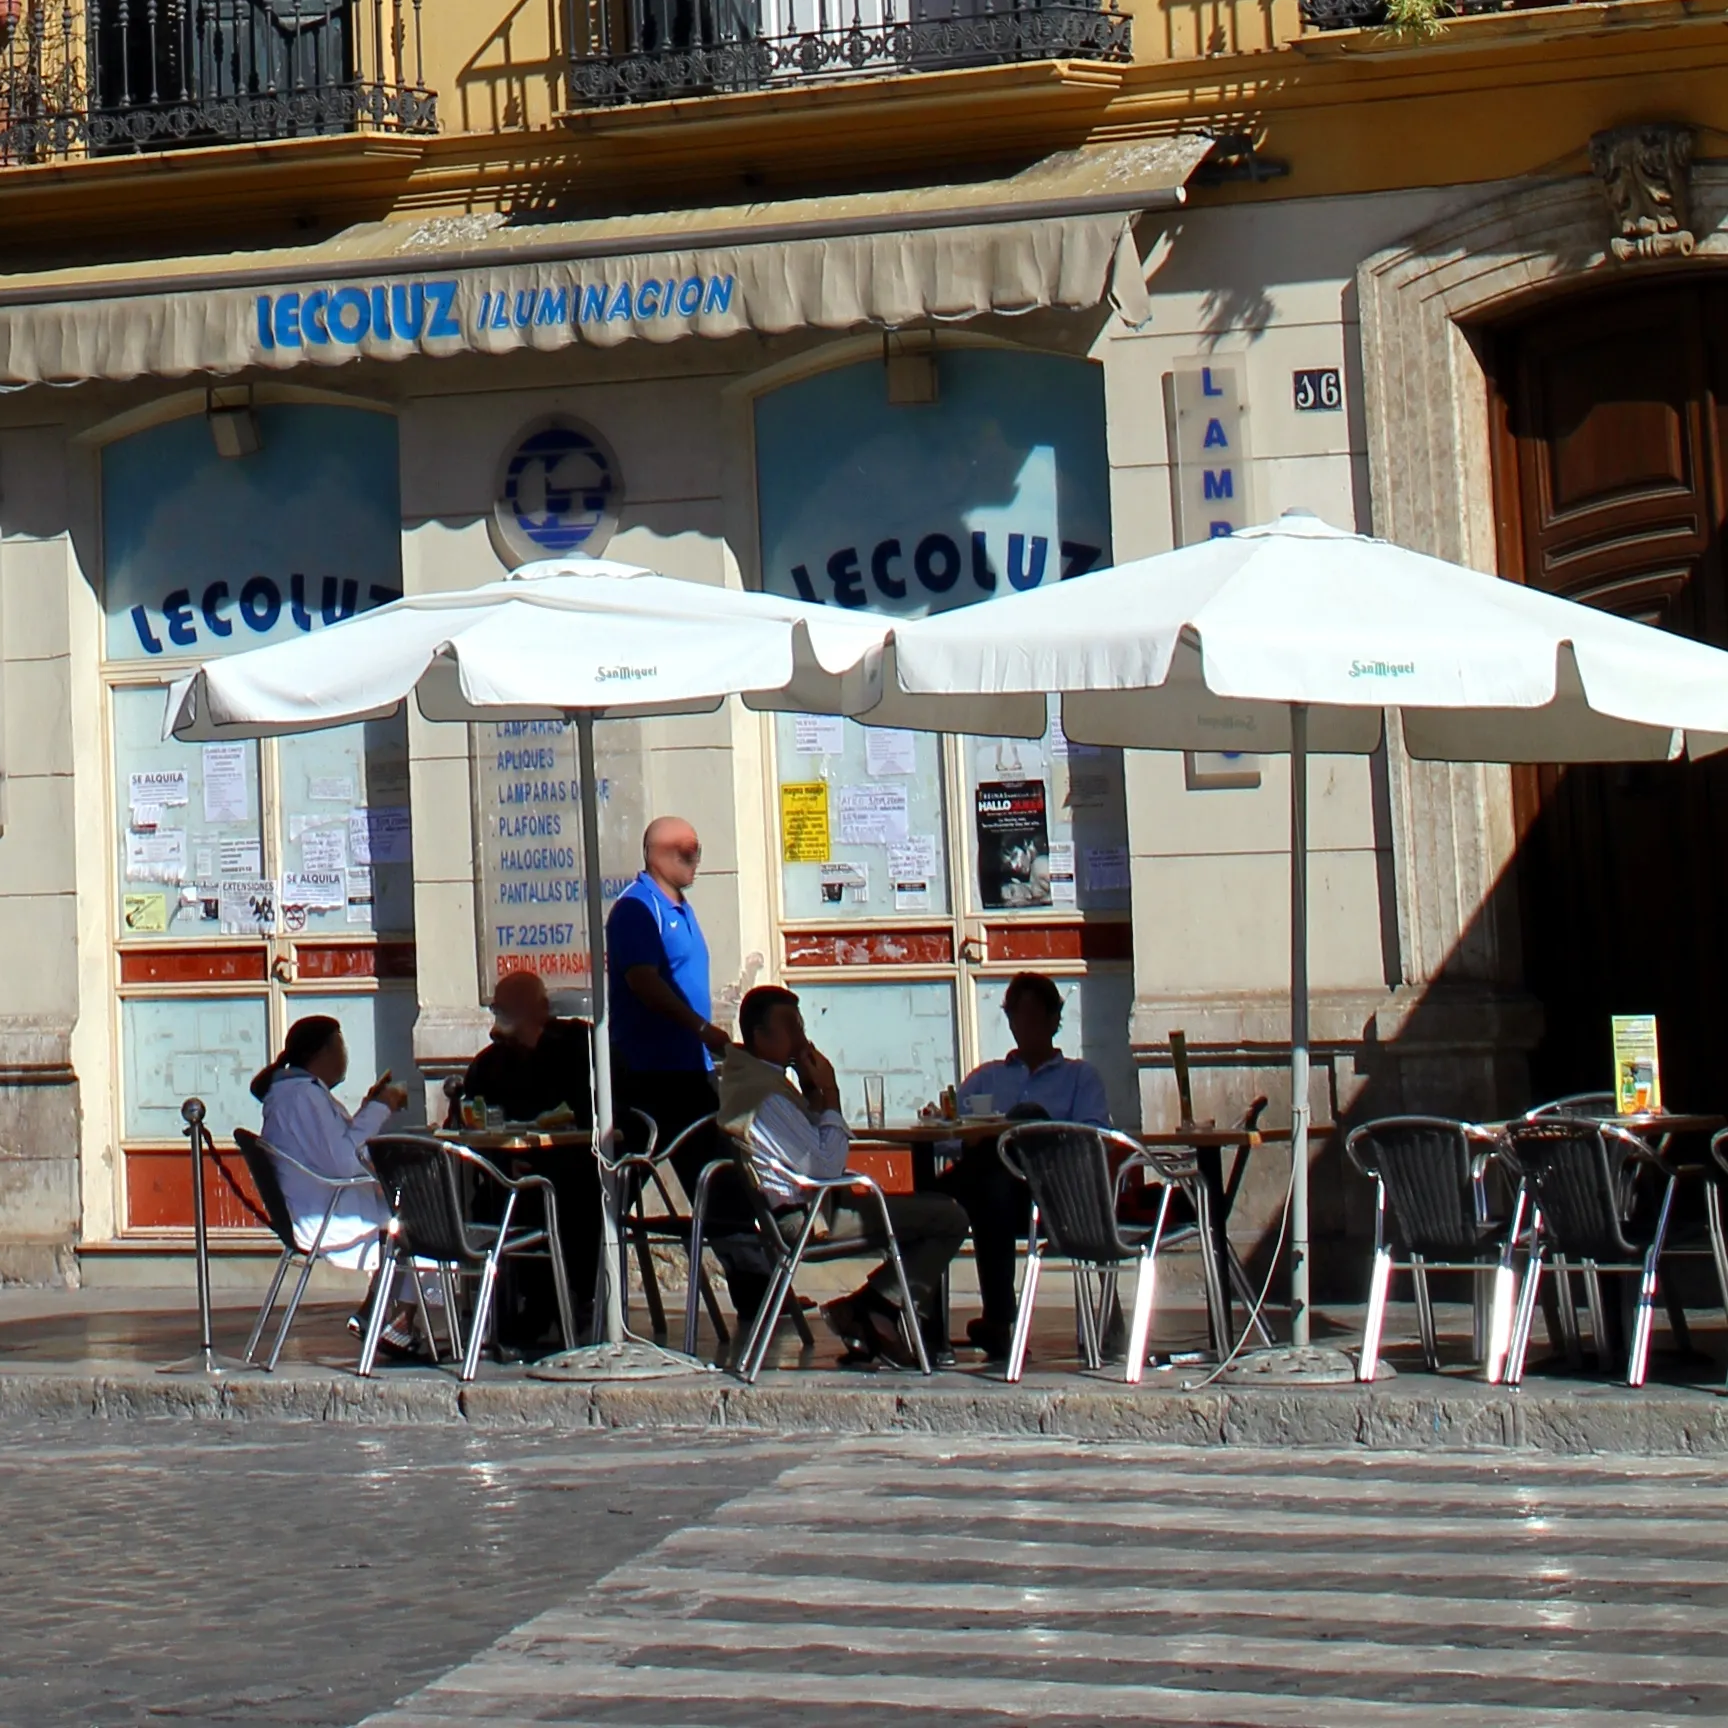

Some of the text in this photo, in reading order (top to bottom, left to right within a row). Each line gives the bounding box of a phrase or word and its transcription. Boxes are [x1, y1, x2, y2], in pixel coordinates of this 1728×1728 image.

[257, 275, 733, 350] LECOLUZ ILUMINACION
[1296, 372, 1339, 407] 16
[497, 748, 555, 770] APLIQUES
[132, 772, 184, 785] SE ALQUILA
[498, 781, 566, 804] LAMPARAS
[499, 814, 561, 837] PLAFONES
[500, 847, 574, 871] HALOGENOS
[286, 874, 340, 884] SE ALQUILA
[500, 881, 562, 905] PANTALLAS
[565, 880, 579, 902] DE
[496, 954, 538, 975] ENTRADA
[539, 953, 558, 974] POR
